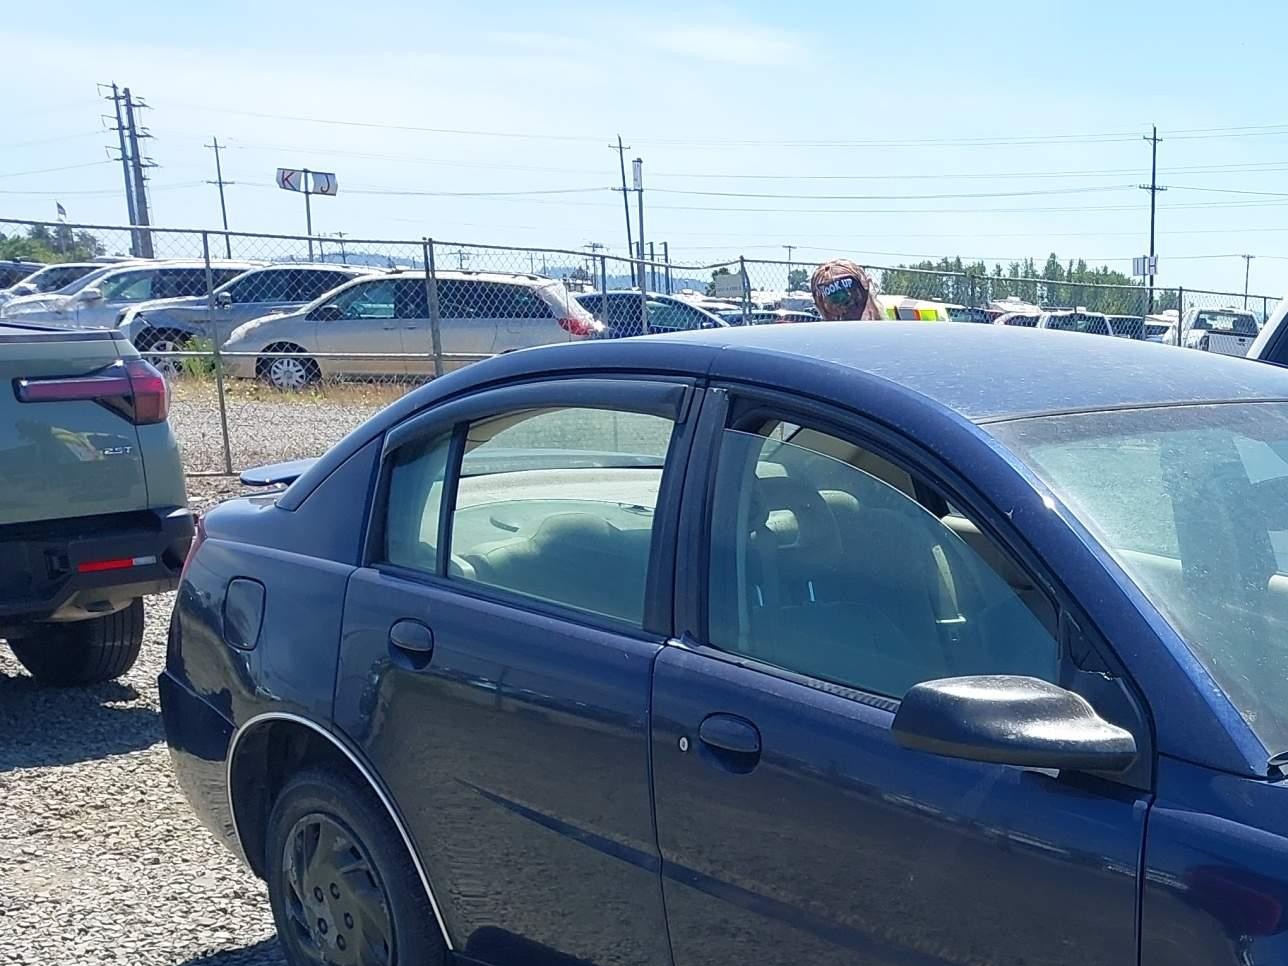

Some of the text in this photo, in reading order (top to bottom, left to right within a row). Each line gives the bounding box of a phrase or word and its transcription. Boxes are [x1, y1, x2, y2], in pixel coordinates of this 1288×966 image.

[281, 169, 297, 191] K
[320, 174, 330, 193] J
[841, 278, 853, 289] UP
